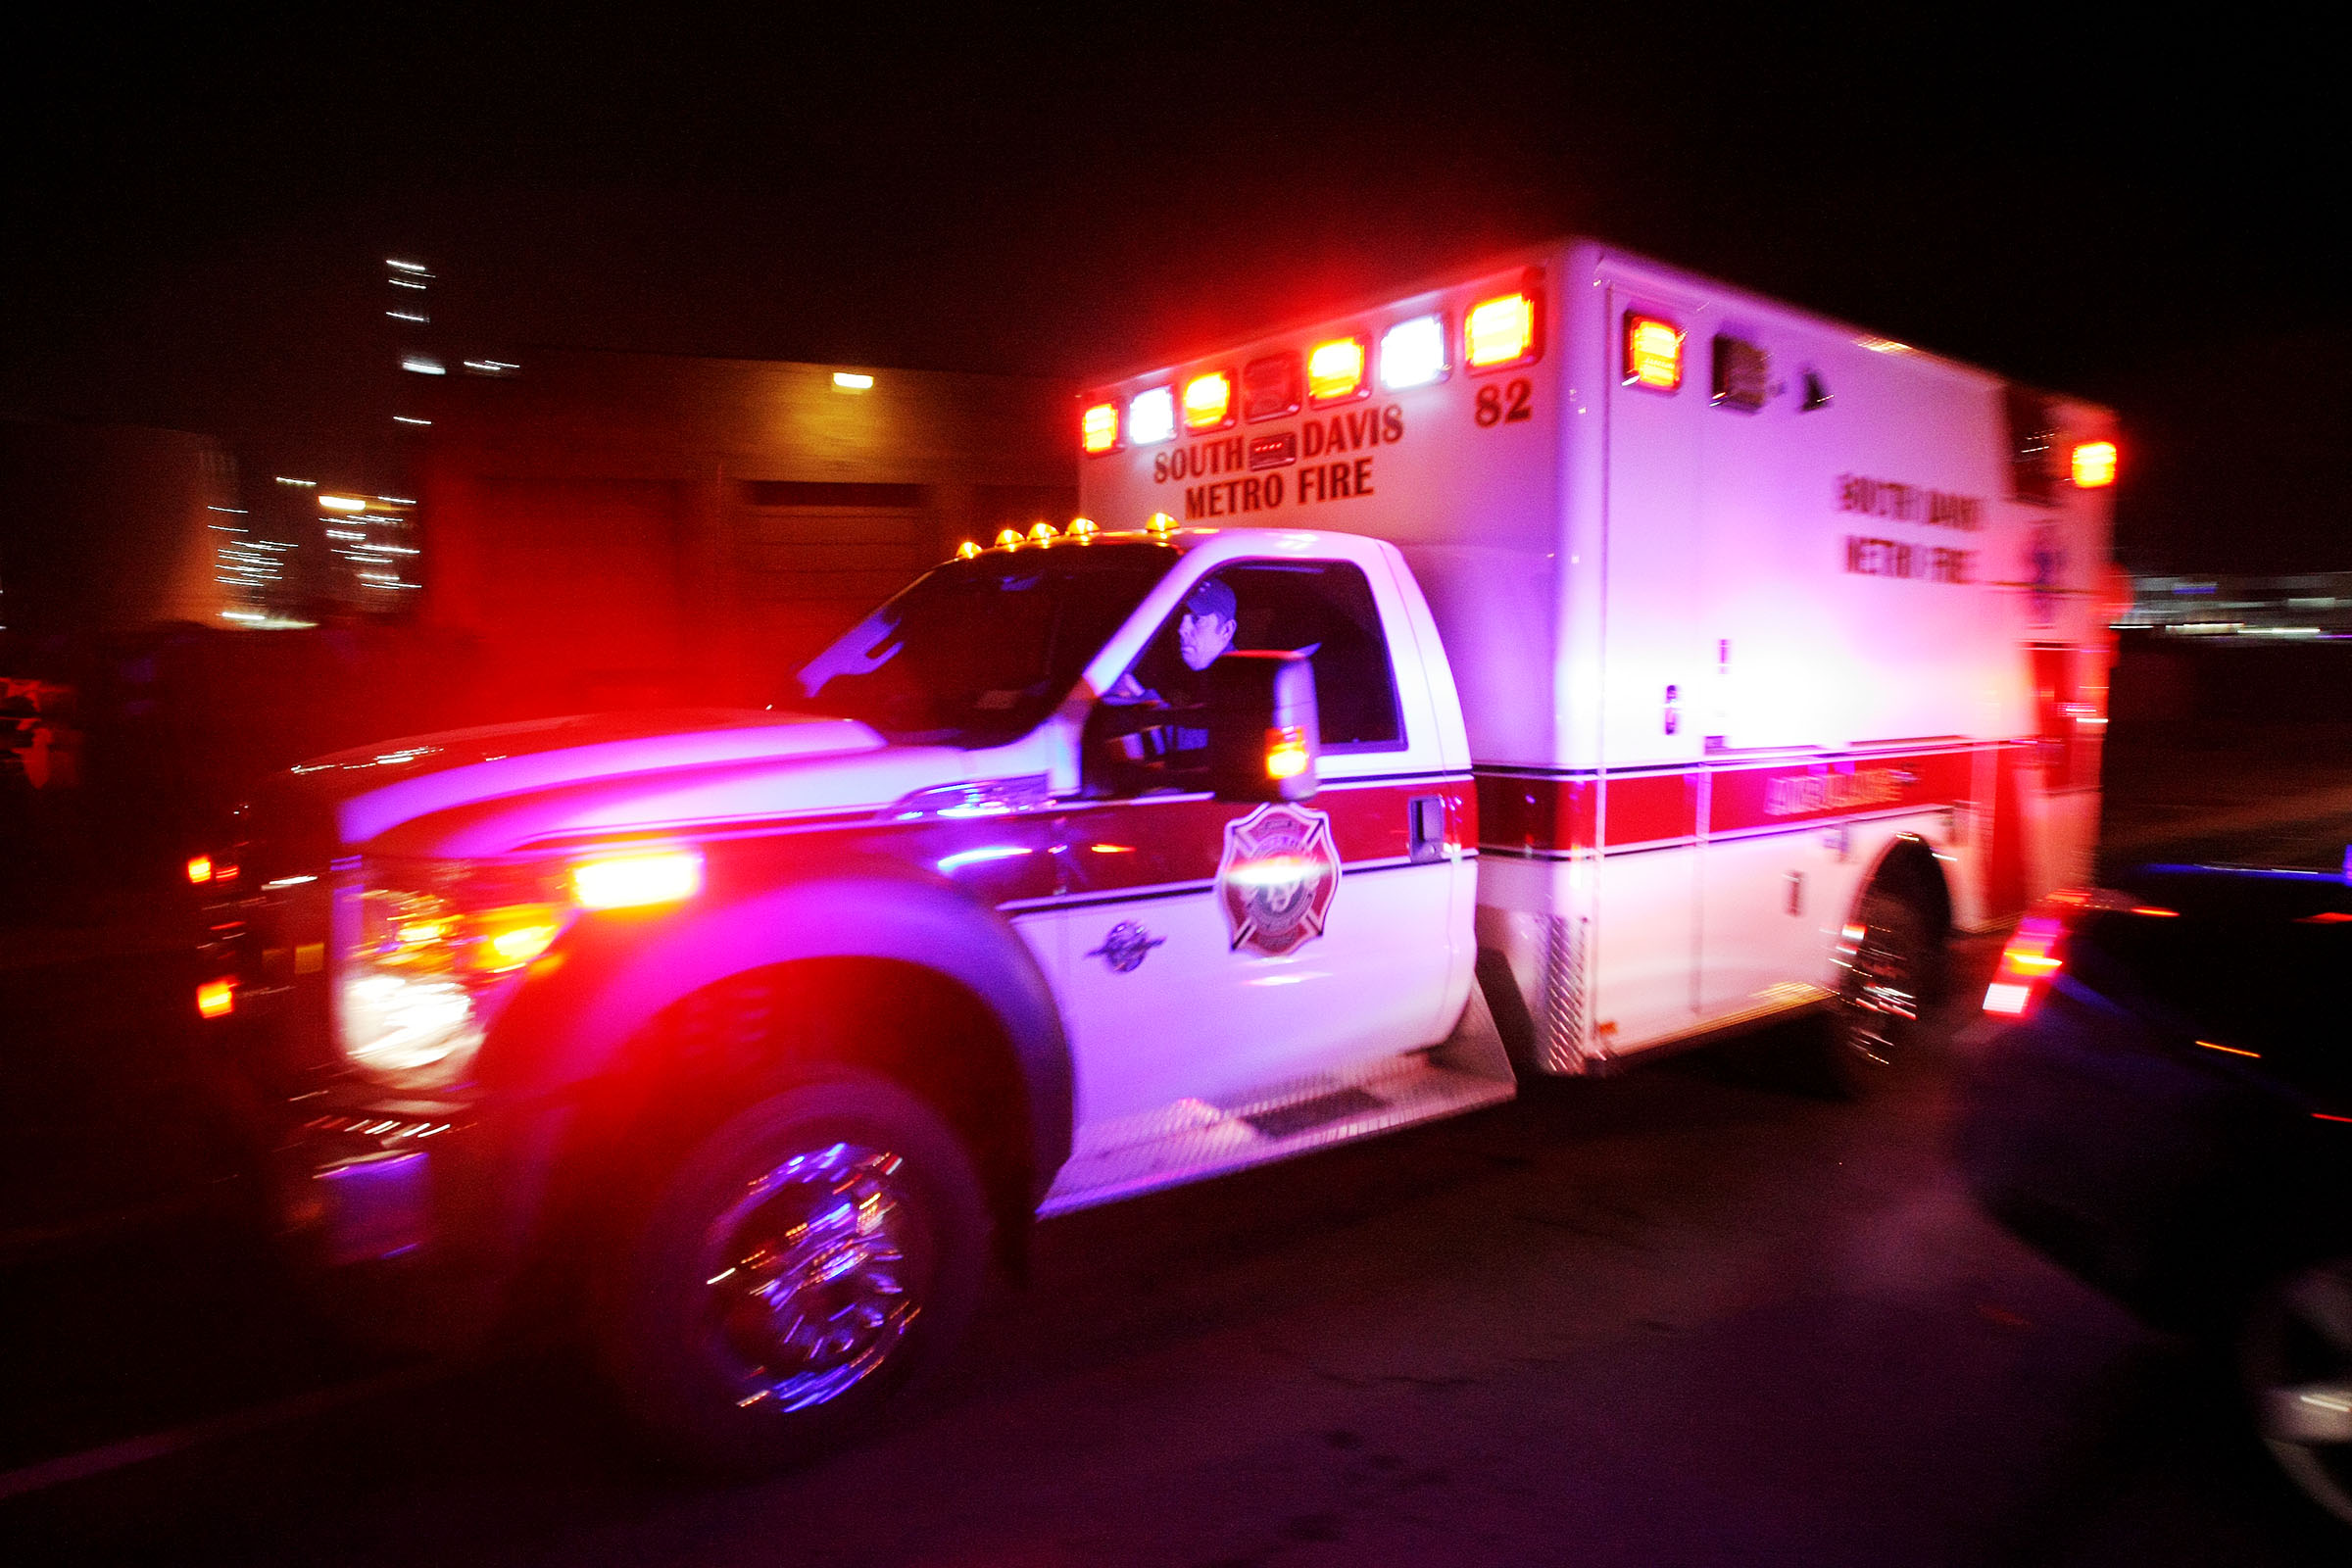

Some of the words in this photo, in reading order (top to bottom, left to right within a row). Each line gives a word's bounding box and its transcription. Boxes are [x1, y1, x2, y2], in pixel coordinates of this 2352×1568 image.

[1475, 377, 1532, 428] 82
[1153, 435, 1244, 484] SOUTH
[1302, 404, 1403, 458] DAVIS
[1185, 472, 1284, 520] METRO
[1297, 457, 1374, 506] FIRE
